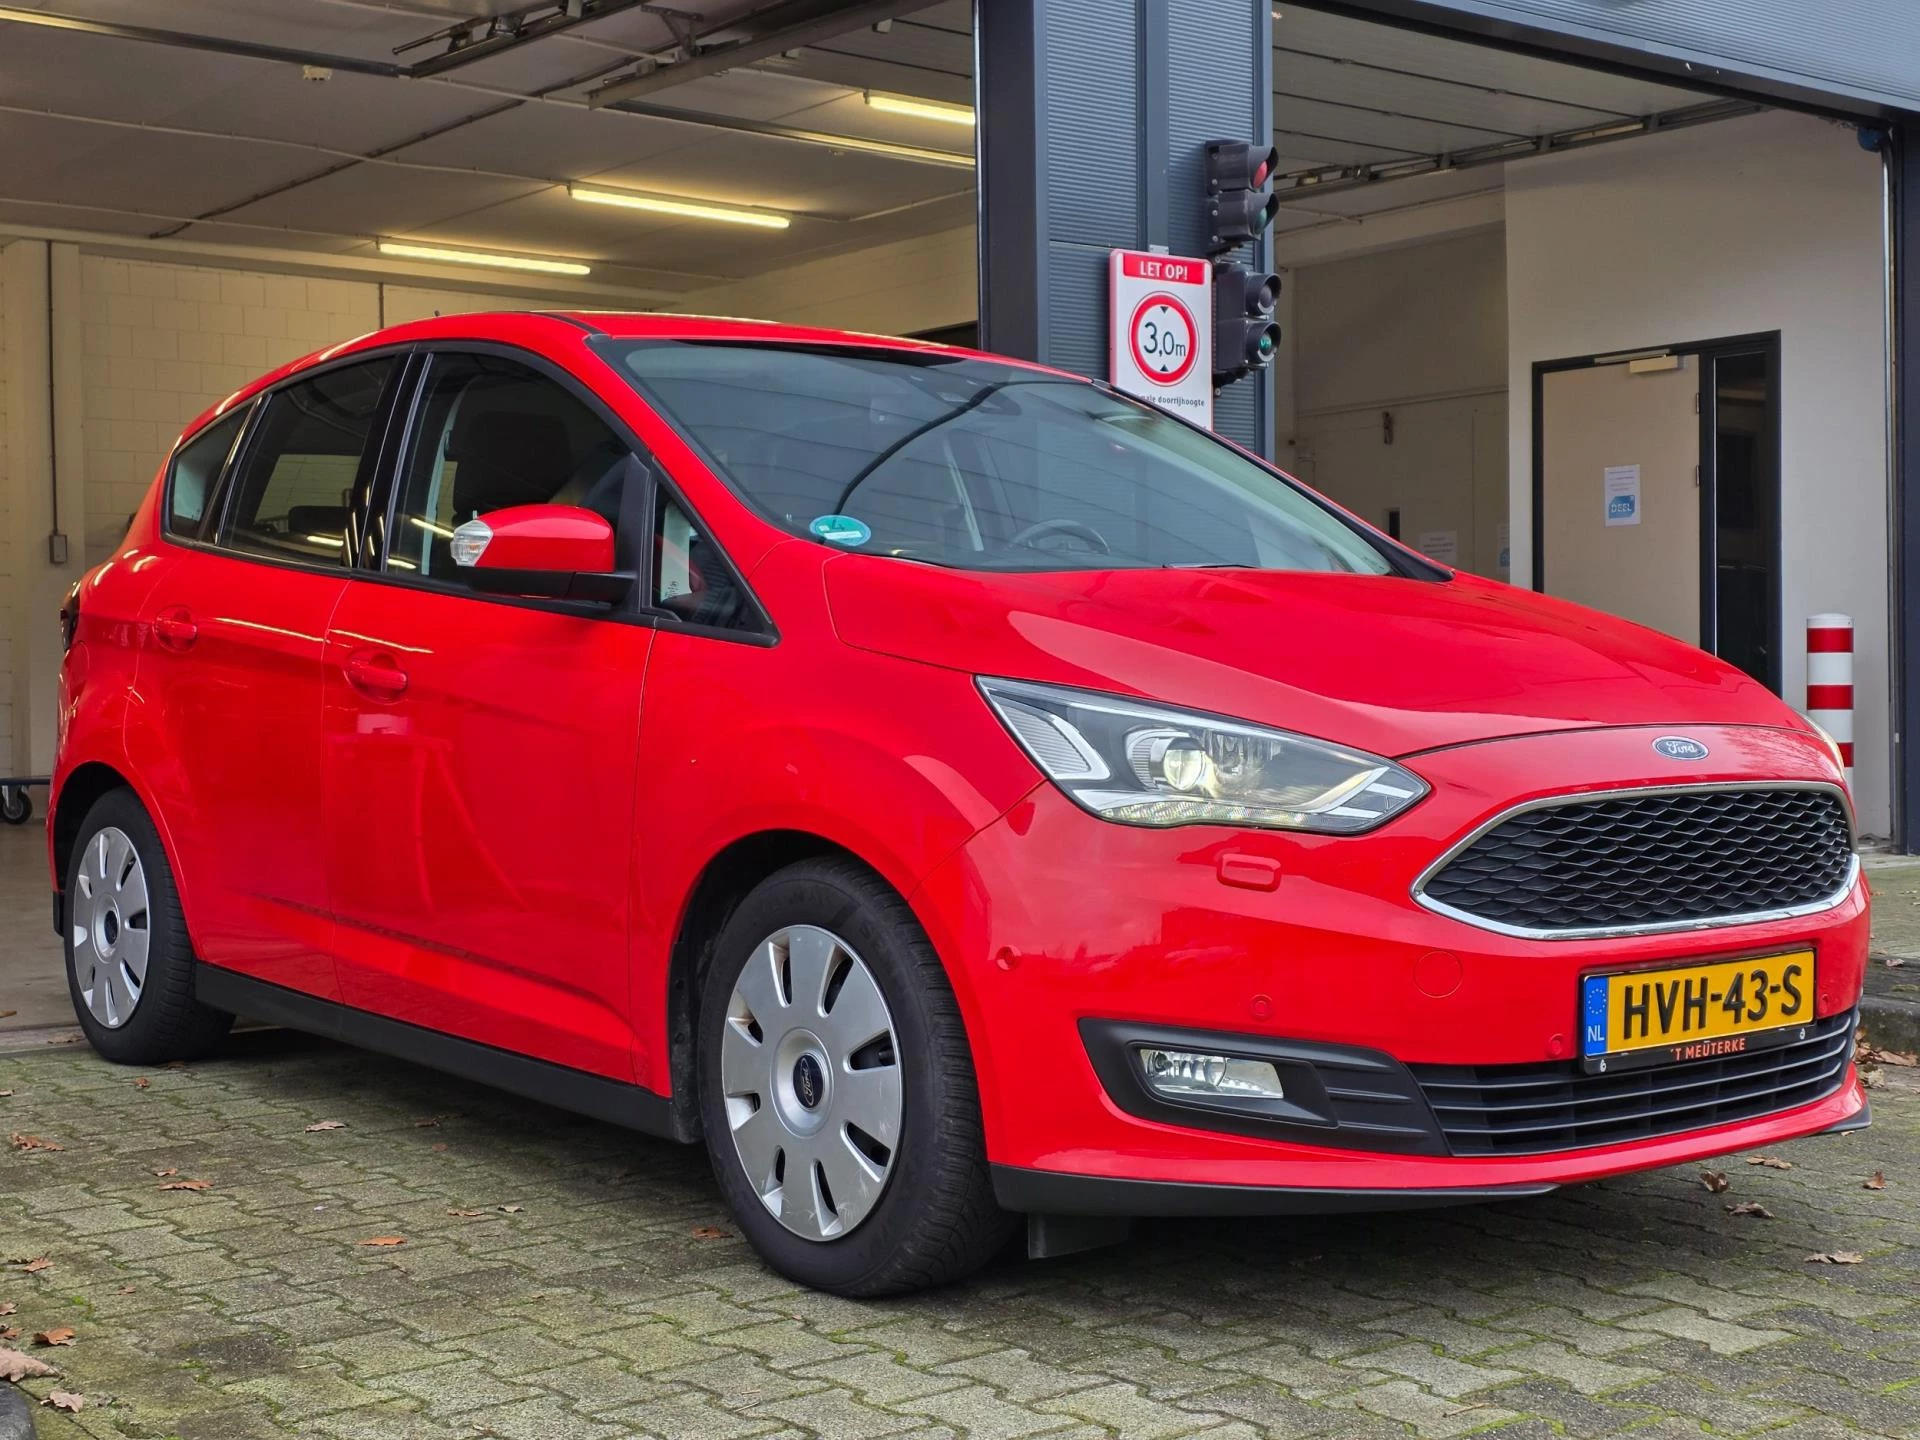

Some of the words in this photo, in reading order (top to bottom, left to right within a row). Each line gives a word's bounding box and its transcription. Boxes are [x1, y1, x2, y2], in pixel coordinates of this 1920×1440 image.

[1139, 260, 1163, 278] LET
[1165, 264, 1189, 281] OP!
[1158, 396, 1205, 408] doorrijhoogte
[1665, 740, 1698, 754] Ford
[1623, 964, 1803, 1041] HVH-43-S
[1587, 1025, 1605, 1043] NL
[1685, 1037, 1747, 1060] MEUTERKE
